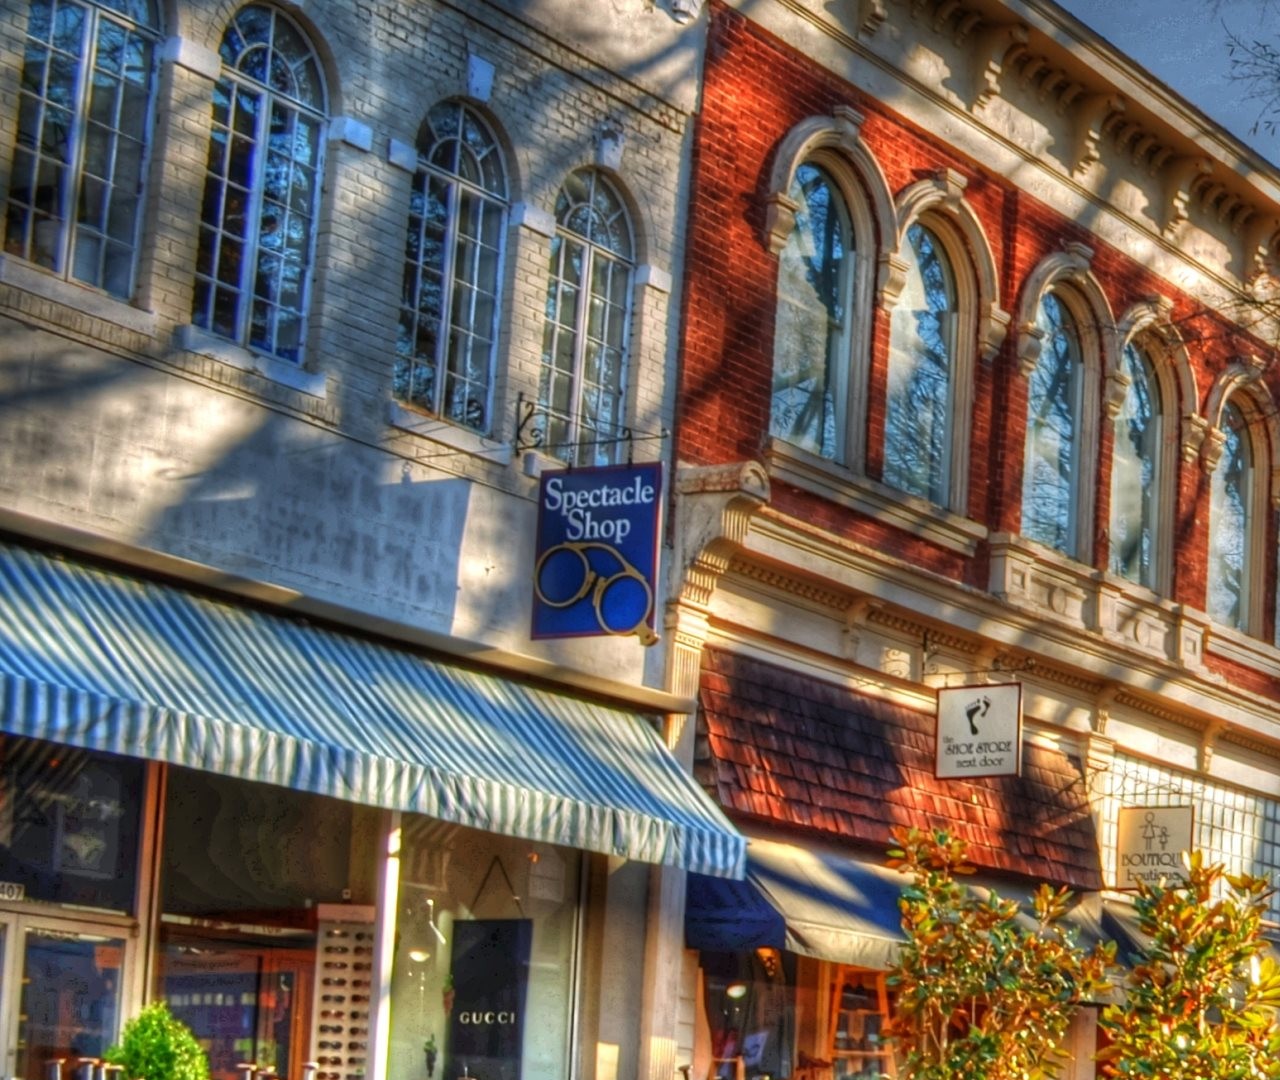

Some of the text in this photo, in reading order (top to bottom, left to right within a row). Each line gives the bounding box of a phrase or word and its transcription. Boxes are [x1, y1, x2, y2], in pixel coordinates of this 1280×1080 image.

[544, 475, 655, 516] Spectacle
[566, 508, 631, 544] Shop
[944, 740, 1012, 756] SHOE STORE
[956, 755, 1004, 768] next door
[459, 1011, 516, 1025] GUCCI
